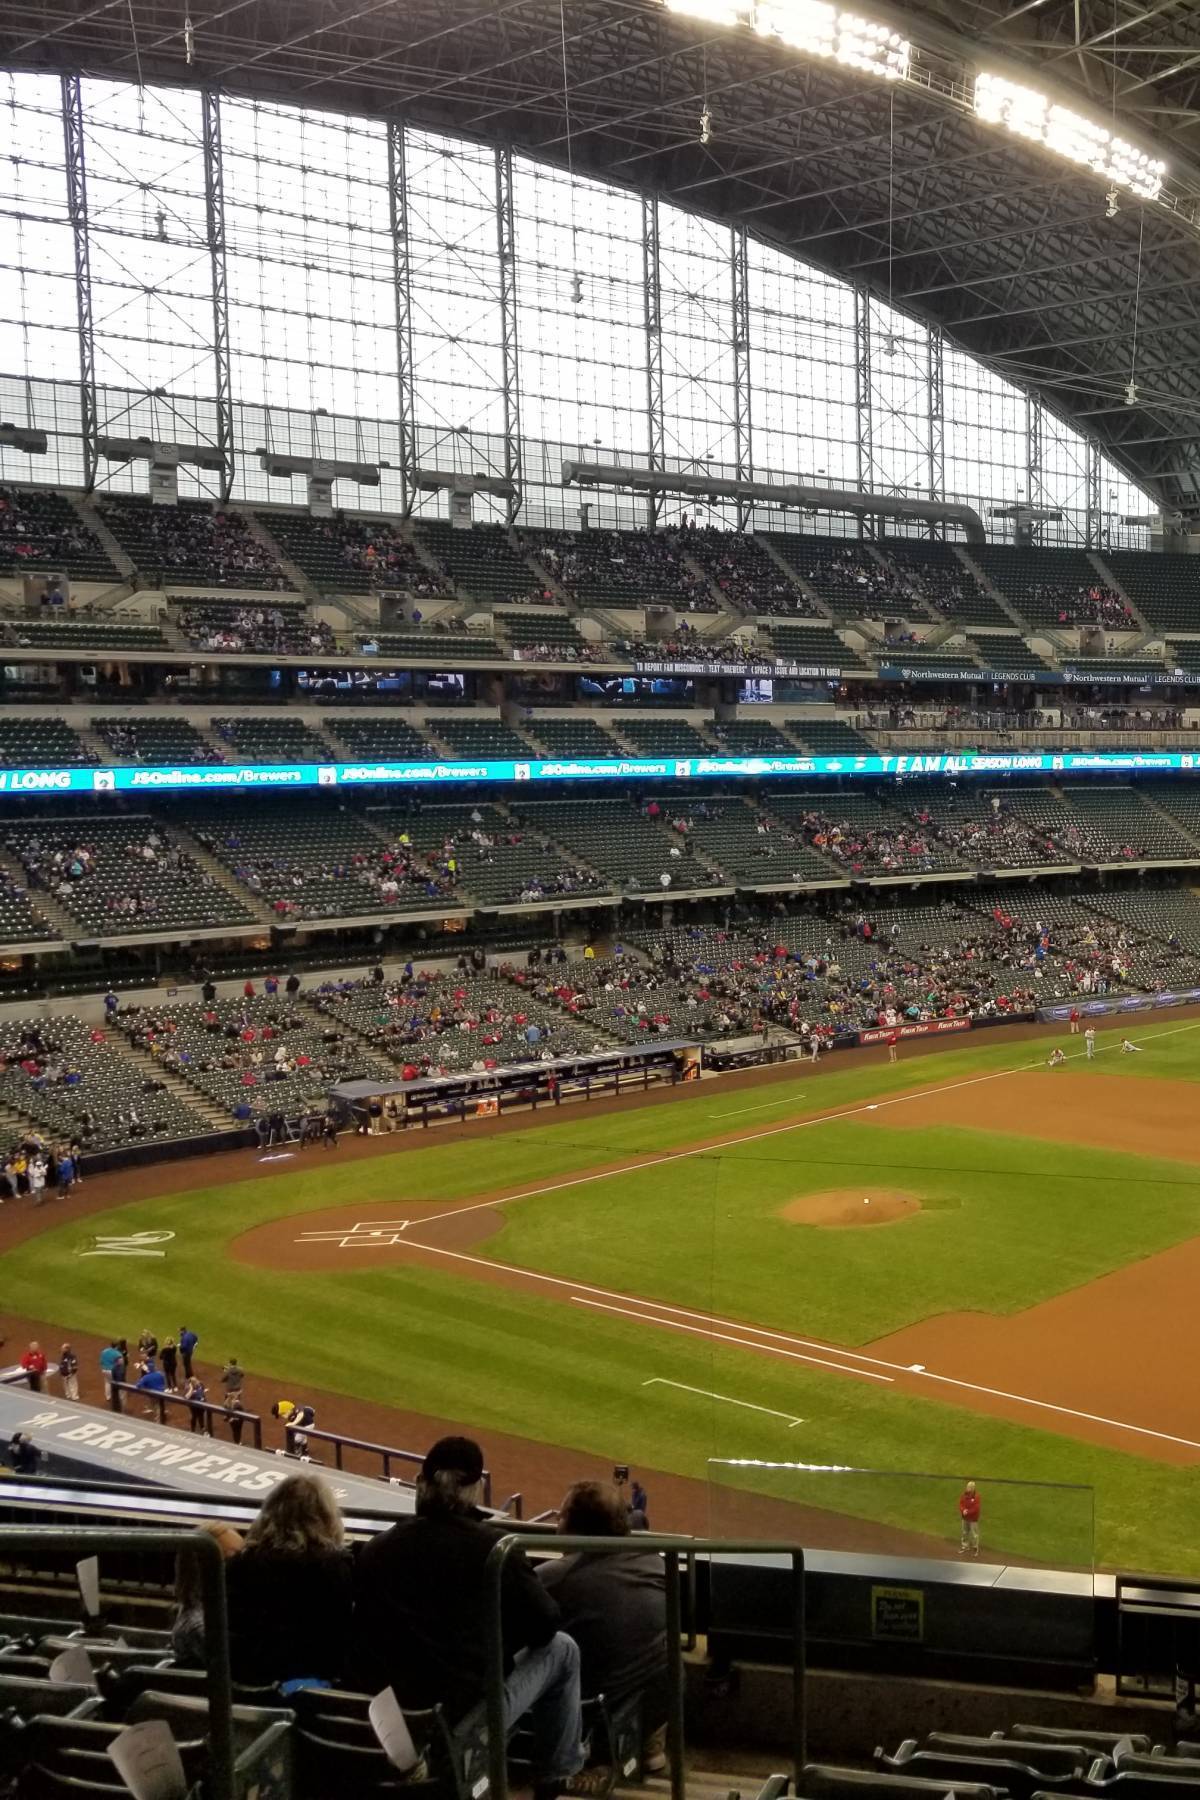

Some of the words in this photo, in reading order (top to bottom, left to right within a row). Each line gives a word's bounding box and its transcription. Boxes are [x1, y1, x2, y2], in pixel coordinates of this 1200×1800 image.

[911, 670, 958, 679] Northwestern
[960, 672, 984, 680] Mutual
[991, 672, 1019, 680] LEGENDS
[1073, 674, 1122, 682] Northwestern
[1122, 674, 1147, 682] Mutual
[1184, 676, 1200, 684] CLUB
[10, 771, 72, 789] LONG
[130, 769, 302, 785] JSOnline.com/Brewers
[57, 1422, 289, 1491] BREWERS
